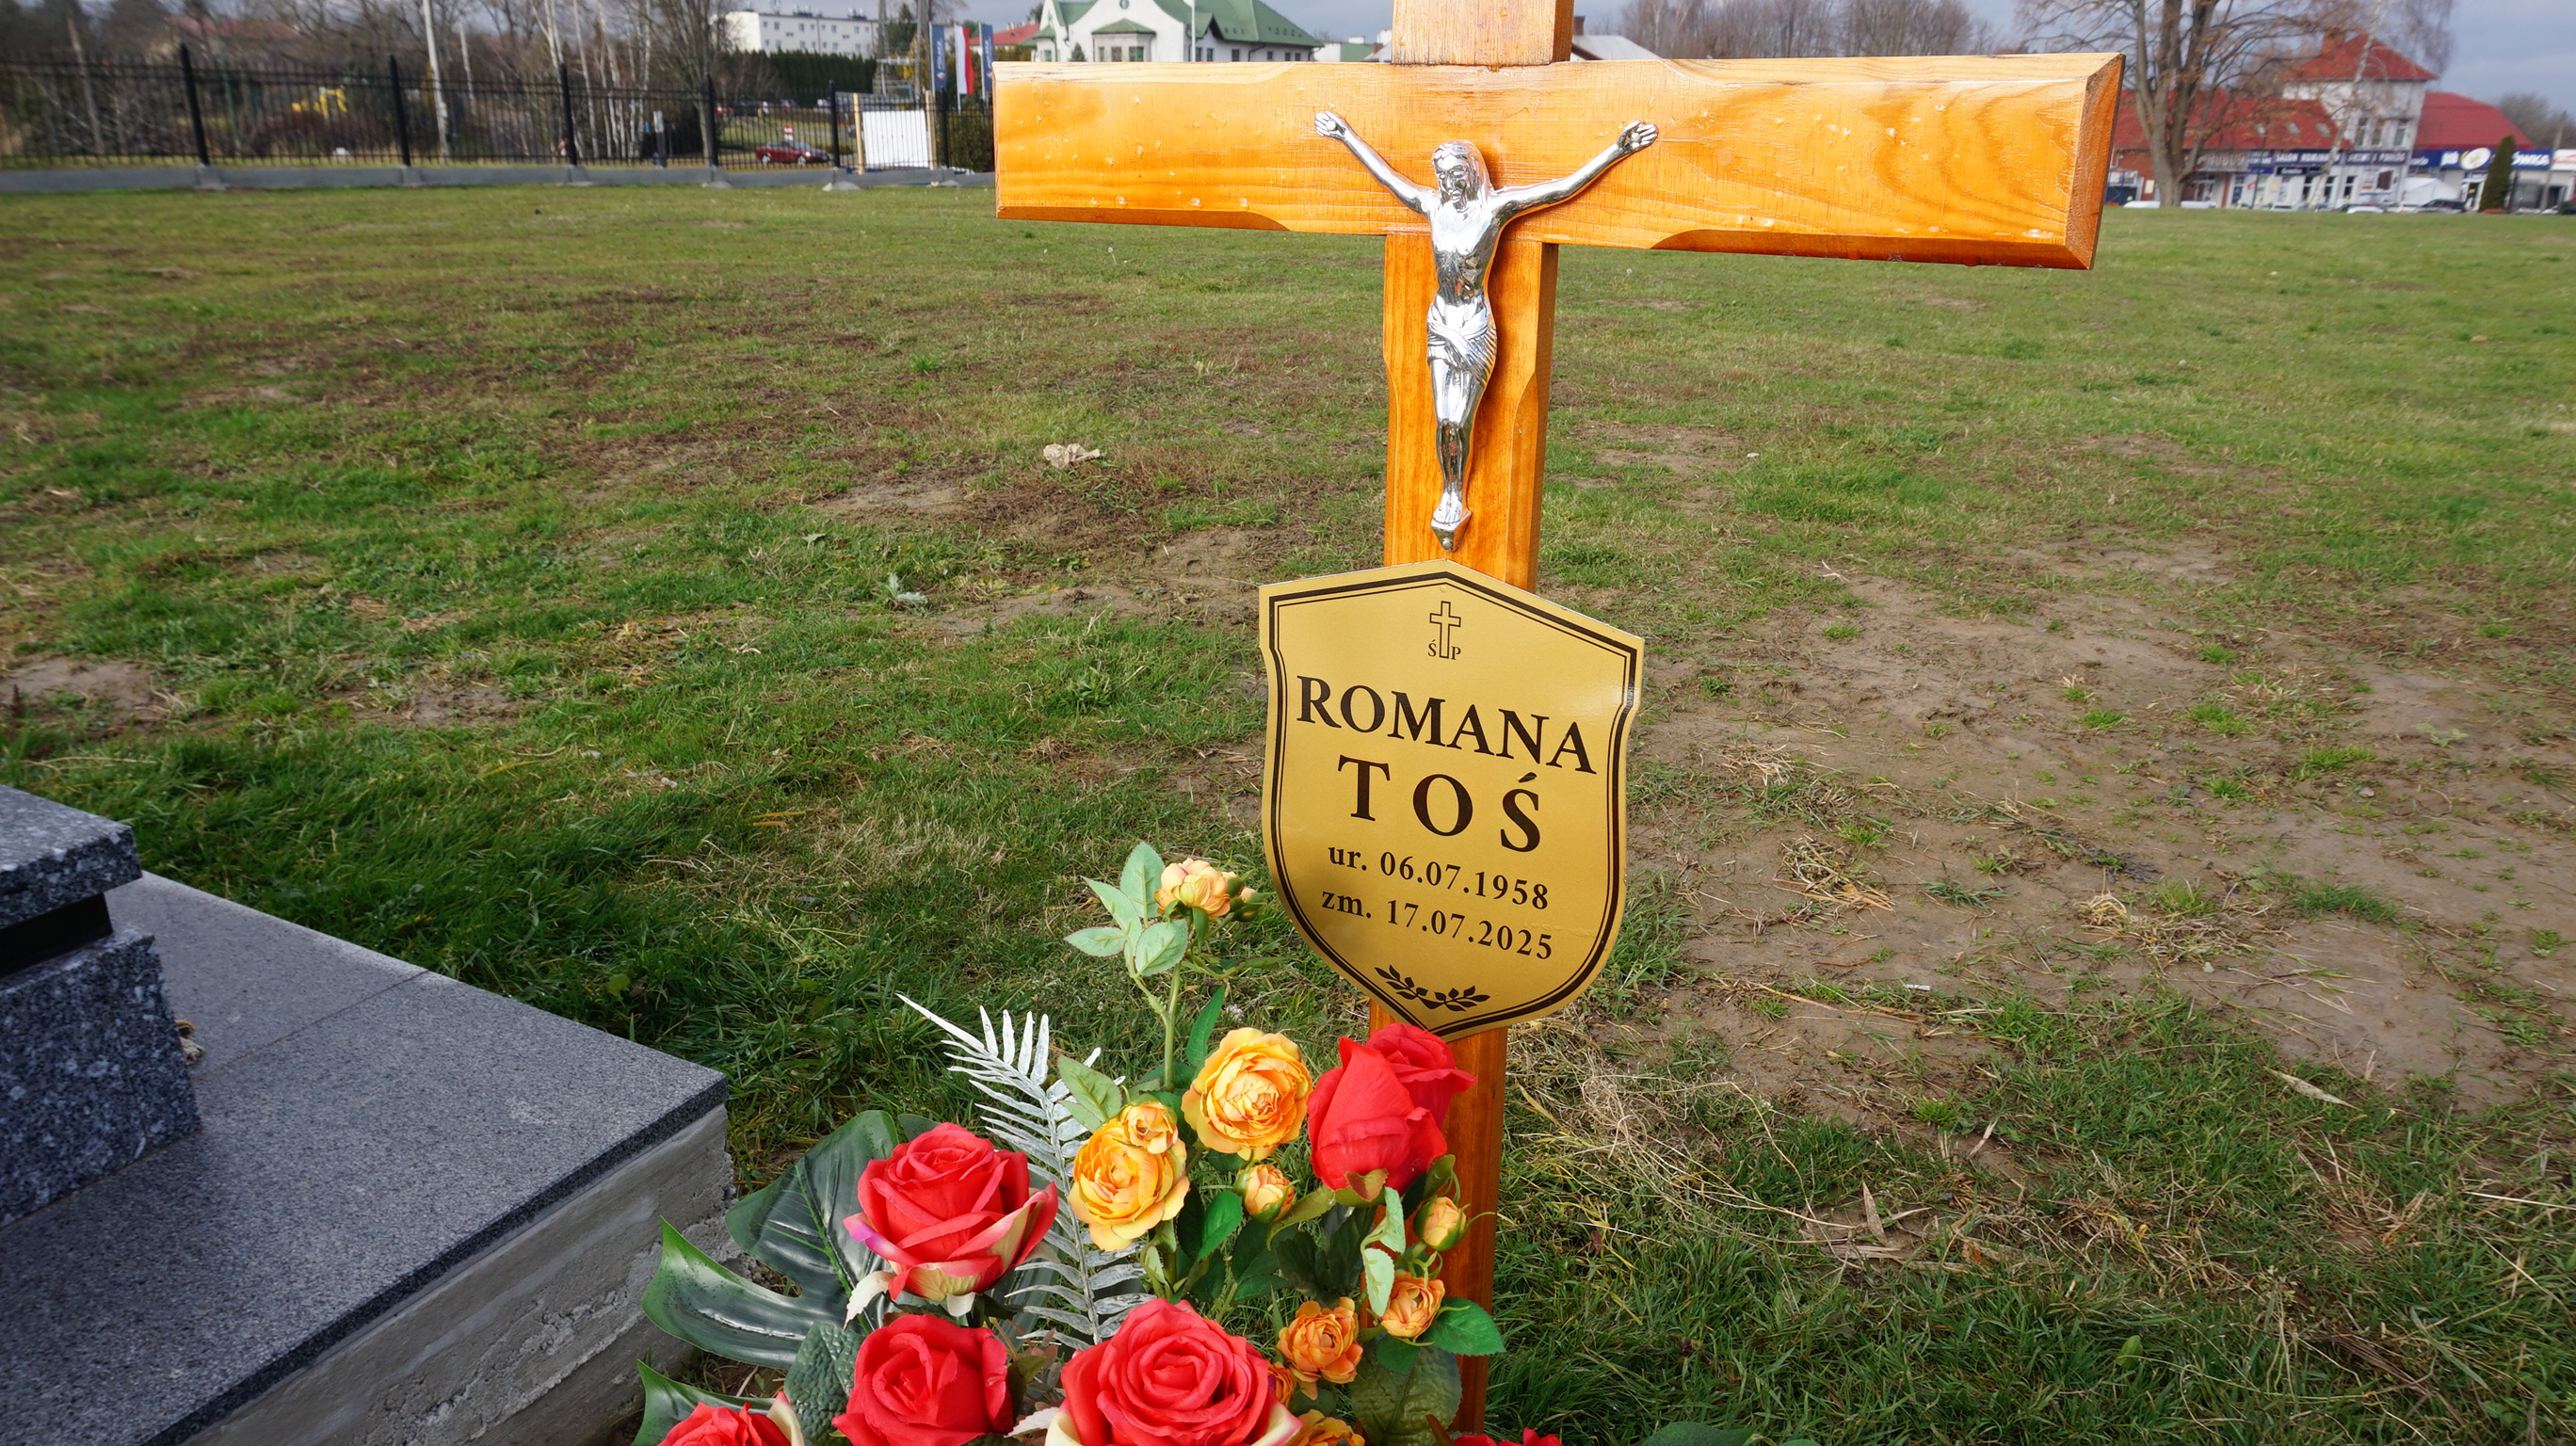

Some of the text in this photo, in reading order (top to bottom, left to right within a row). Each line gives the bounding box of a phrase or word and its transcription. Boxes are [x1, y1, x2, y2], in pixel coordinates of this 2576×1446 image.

[1296, 675, 1598, 776] ROMANA
[1337, 754, 1540, 853] TOŚ
[1328, 846, 1549, 910] ur. 06.07.1958
[1321, 891, 1553, 960] zm. 17.07.2025
